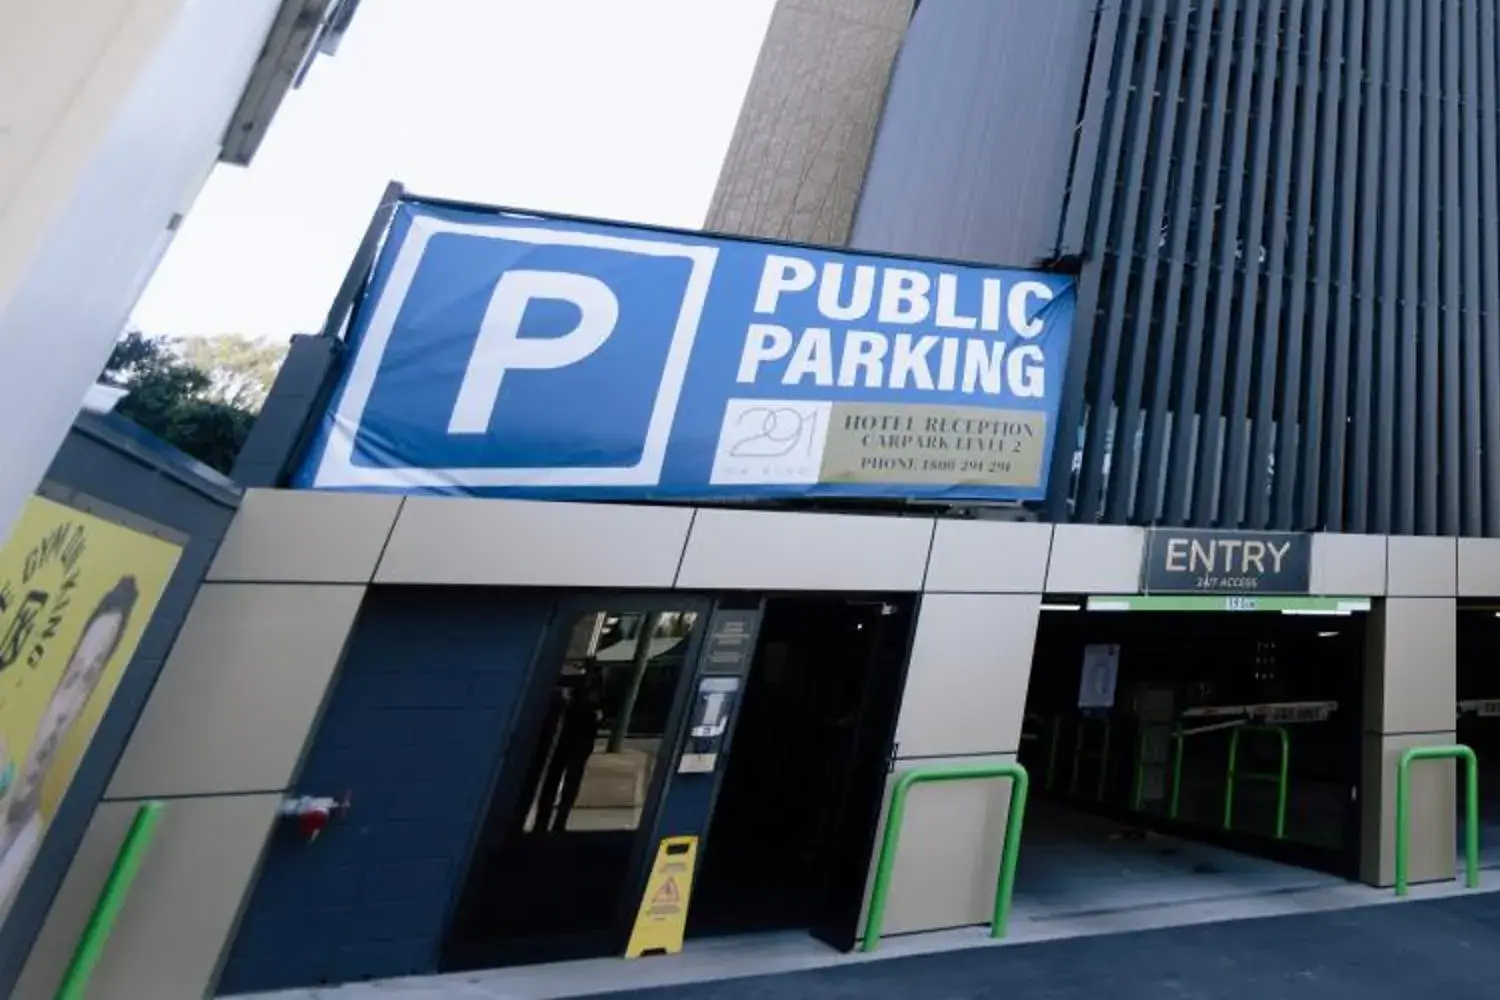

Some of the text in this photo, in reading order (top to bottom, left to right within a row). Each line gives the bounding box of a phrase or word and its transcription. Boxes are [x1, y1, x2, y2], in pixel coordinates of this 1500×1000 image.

[754, 254, 1053, 339] PUBLIC
[446, 269, 619, 435] P
[736, 322, 1046, 398] PARKING
[728, 407, 818, 457] 291
[844, 414, 1034, 438] HOTEL RECEPTION
[861, 434, 1022, 454] CARPARK LEVEL 2
[860, 458, 918, 471] PHONE
[1165, 537, 1291, 574] ENTRY
[1219, 576, 1258, 589] ACCESS
